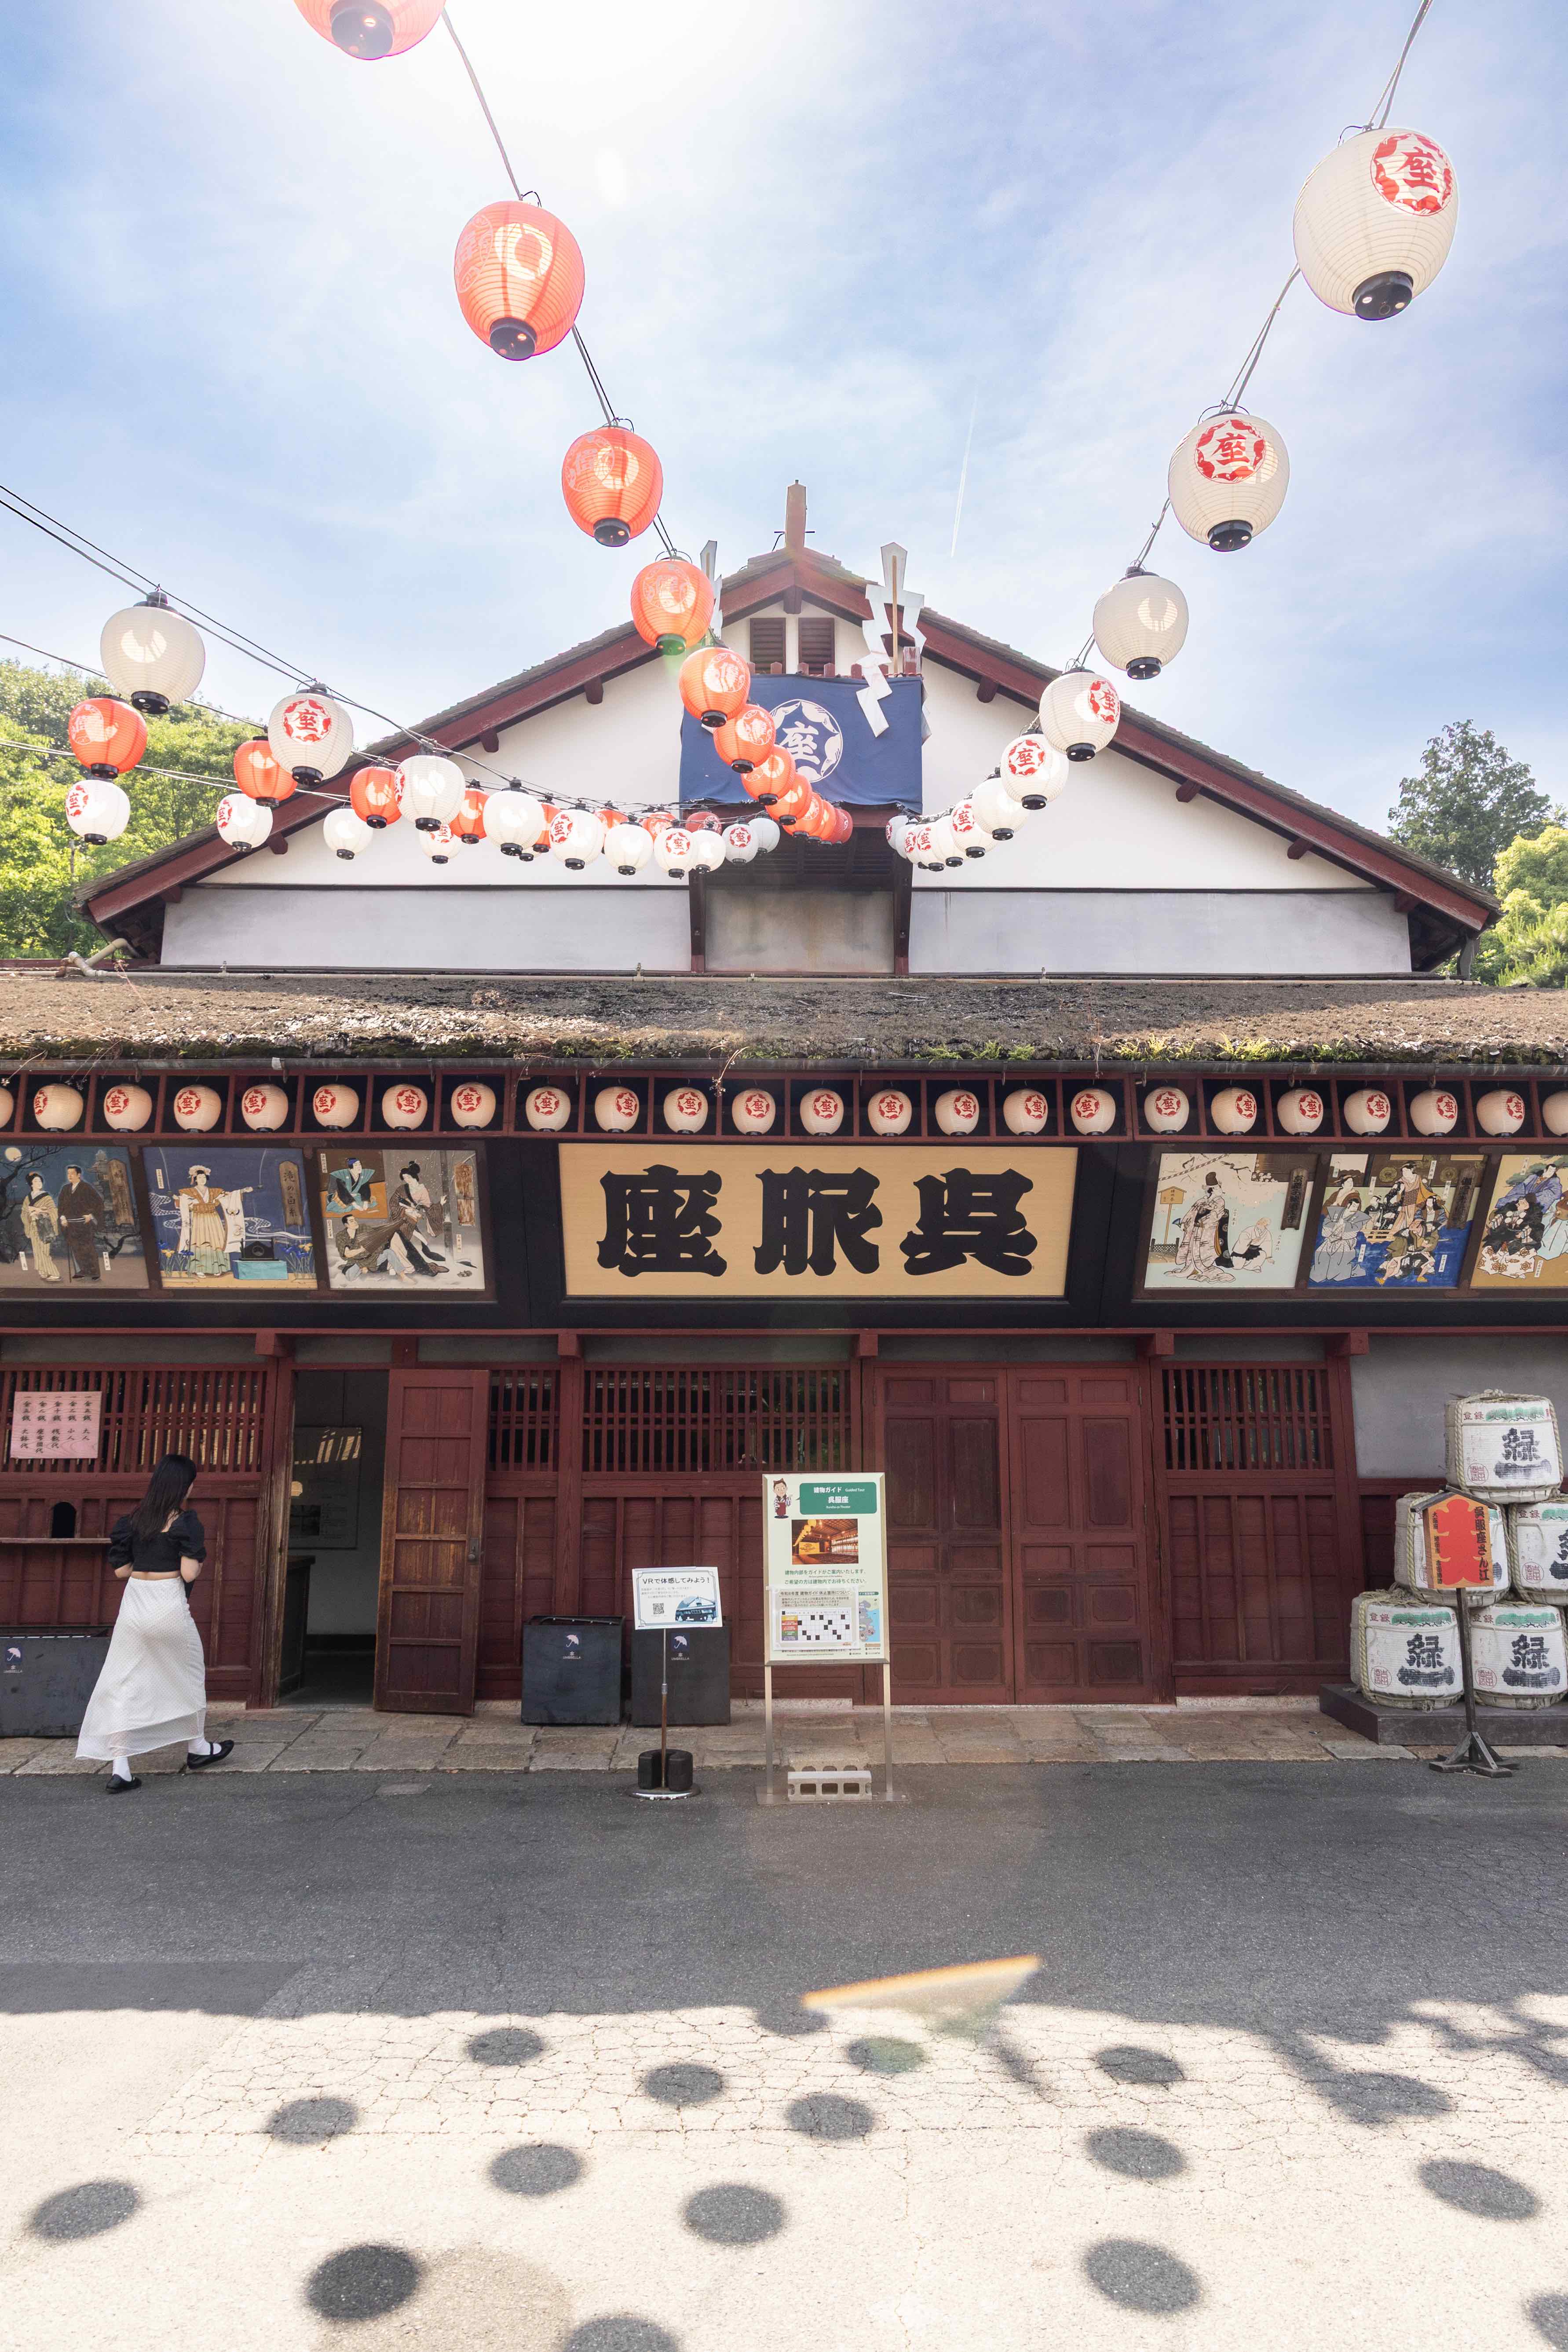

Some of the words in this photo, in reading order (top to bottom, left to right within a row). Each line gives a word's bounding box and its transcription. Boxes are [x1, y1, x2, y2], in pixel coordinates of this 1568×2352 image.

[1396, 146, 1440, 192] 座
[1211, 433, 1249, 465] 座
[1100, 689, 1115, 713] 座
[292, 709, 318, 732] 座
[777, 721, 821, 765] 座
[1015, 747, 1035, 767] 座
[69, 793, 80, 809] 座
[218, 807, 226, 821] 座
[958, 810, 972, 825] 座
[554, 821, 565, 836] 座
[735, 831, 746, 842] 座
[920, 832, 931, 845] 座
[673, 838, 684, 849] 座
[110, 1096, 121, 1108] 座
[183, 1097, 193, 1108] 座
[249, 1096, 258, 1108] 座
[318, 1096, 329, 1108] 座
[402, 1095, 416, 1107] 座
[461, 1094, 474, 1105] 座
[541, 1097, 553, 1109] 座
[623, 1097, 633, 1110] 座
[684, 1097, 696, 1109] 座
[1162, 1097, 1175, 1110] 座
[752, 1100, 765, 1112] 座
[819, 1100, 832, 1112] 座
[885, 1101, 898, 1113] 座
[960, 1101, 973, 1113] 座
[1031, 1101, 1042, 1113] 座
[1081, 1101, 1093, 1112] 座
[1243, 1100, 1253, 1112] 座
[1305, 1100, 1318, 1112] 座
[1374, 1100, 1386, 1112] 座
[1443, 1101, 1455, 1113] 座
[1513, 1101, 1523, 1113] 座
[284, 1171, 297, 1217] 滝の白糸
[596, 1164, 1038, 1277] 呉服座
[1463, 1412, 1484, 1420] 登録
[1369, 1613, 1390, 1622] 登録
[1473, 1614, 1494, 1624] 登録
